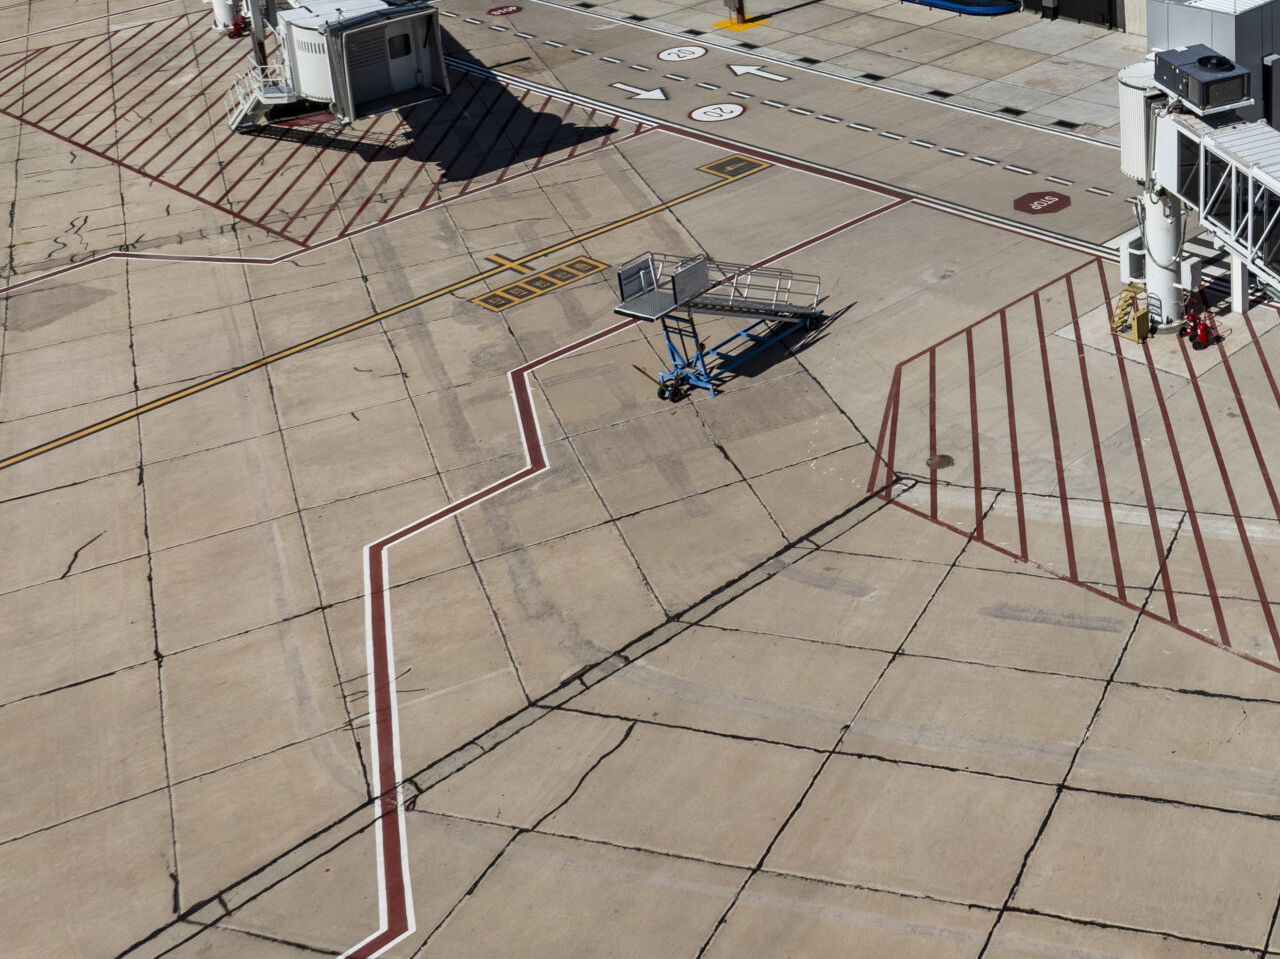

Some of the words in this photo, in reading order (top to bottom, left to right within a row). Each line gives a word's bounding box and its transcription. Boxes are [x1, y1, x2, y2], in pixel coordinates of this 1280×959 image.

[667, 49, 696, 59] 20
[703, 106, 734, 118] 20
[1029, 195, 1059, 210] STOP
